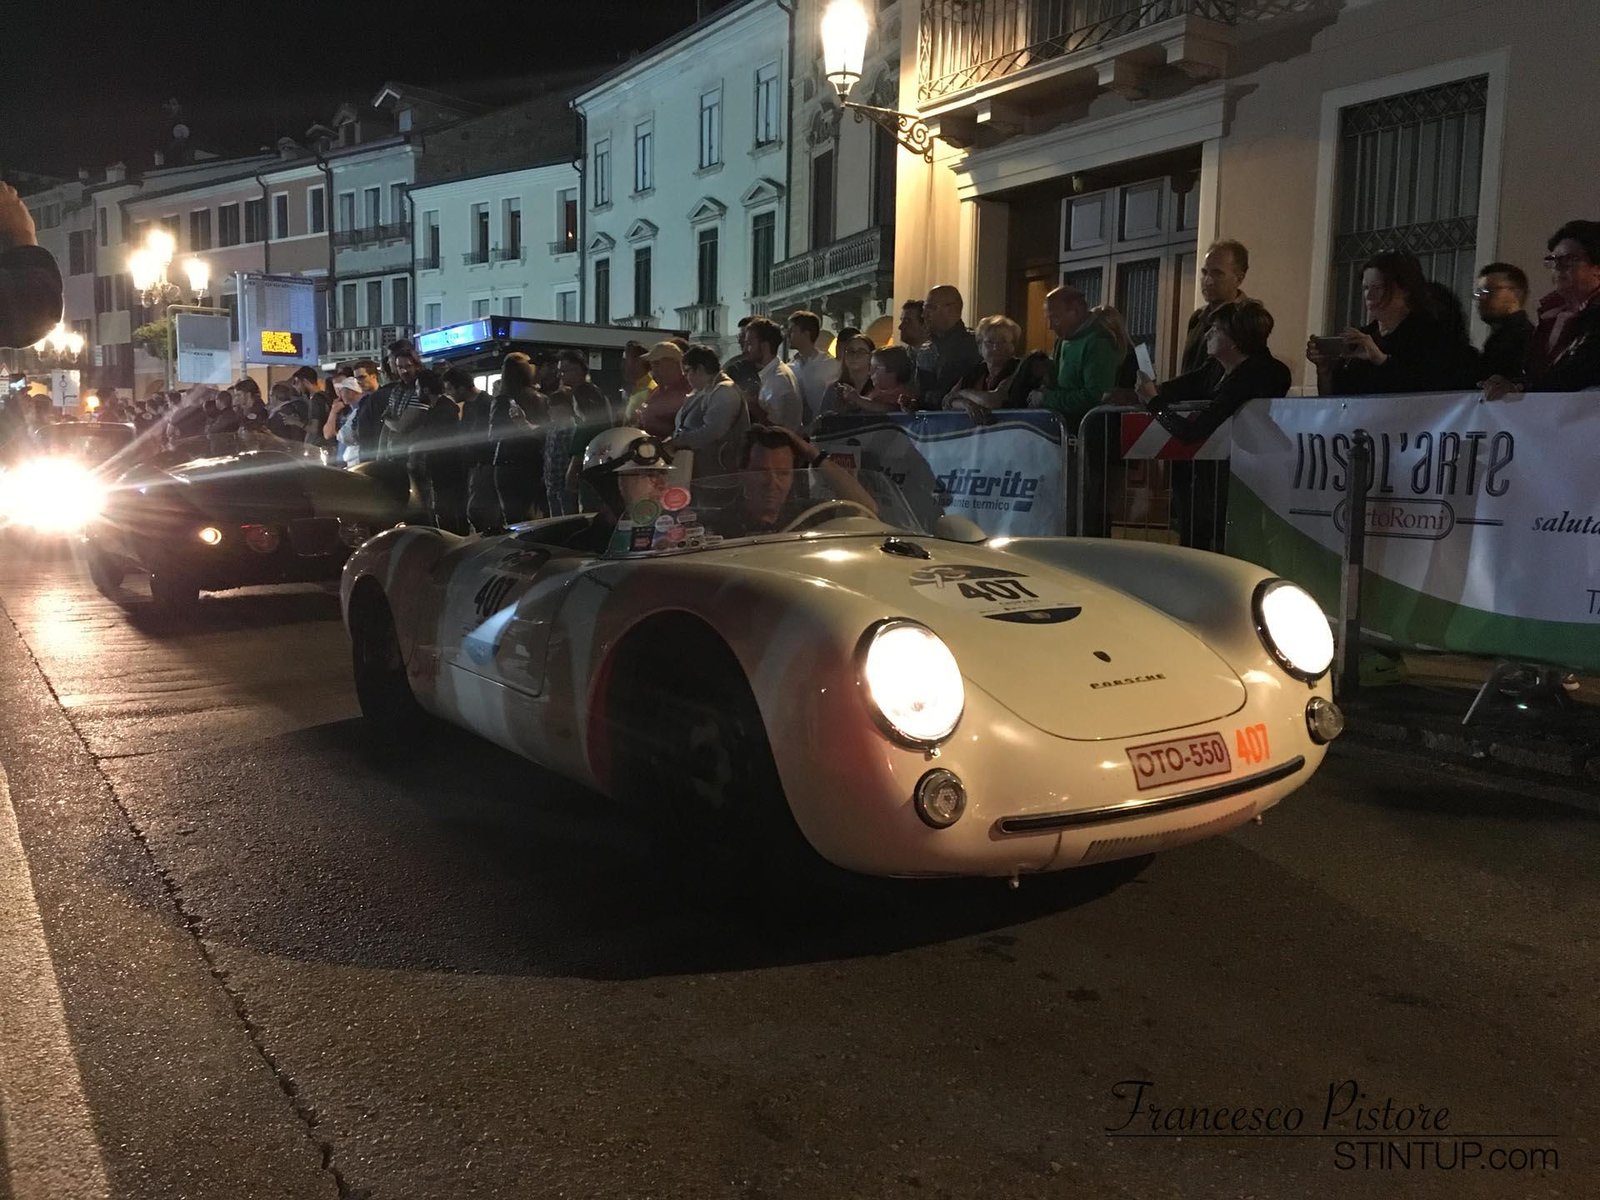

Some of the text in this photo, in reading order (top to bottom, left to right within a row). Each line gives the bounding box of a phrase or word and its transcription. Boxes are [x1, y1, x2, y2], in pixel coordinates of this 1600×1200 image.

[934, 468, 1040, 499] stiferite
[973, 498, 1010, 511] termico
[1342, 506, 1446, 531] toRomi
[957, 579, 1040, 602] 407
[1090, 674, 1166, 689] PORSCHE
[1236, 722, 1271, 766] 407
[1136, 739, 1225, 777] OTO-550
